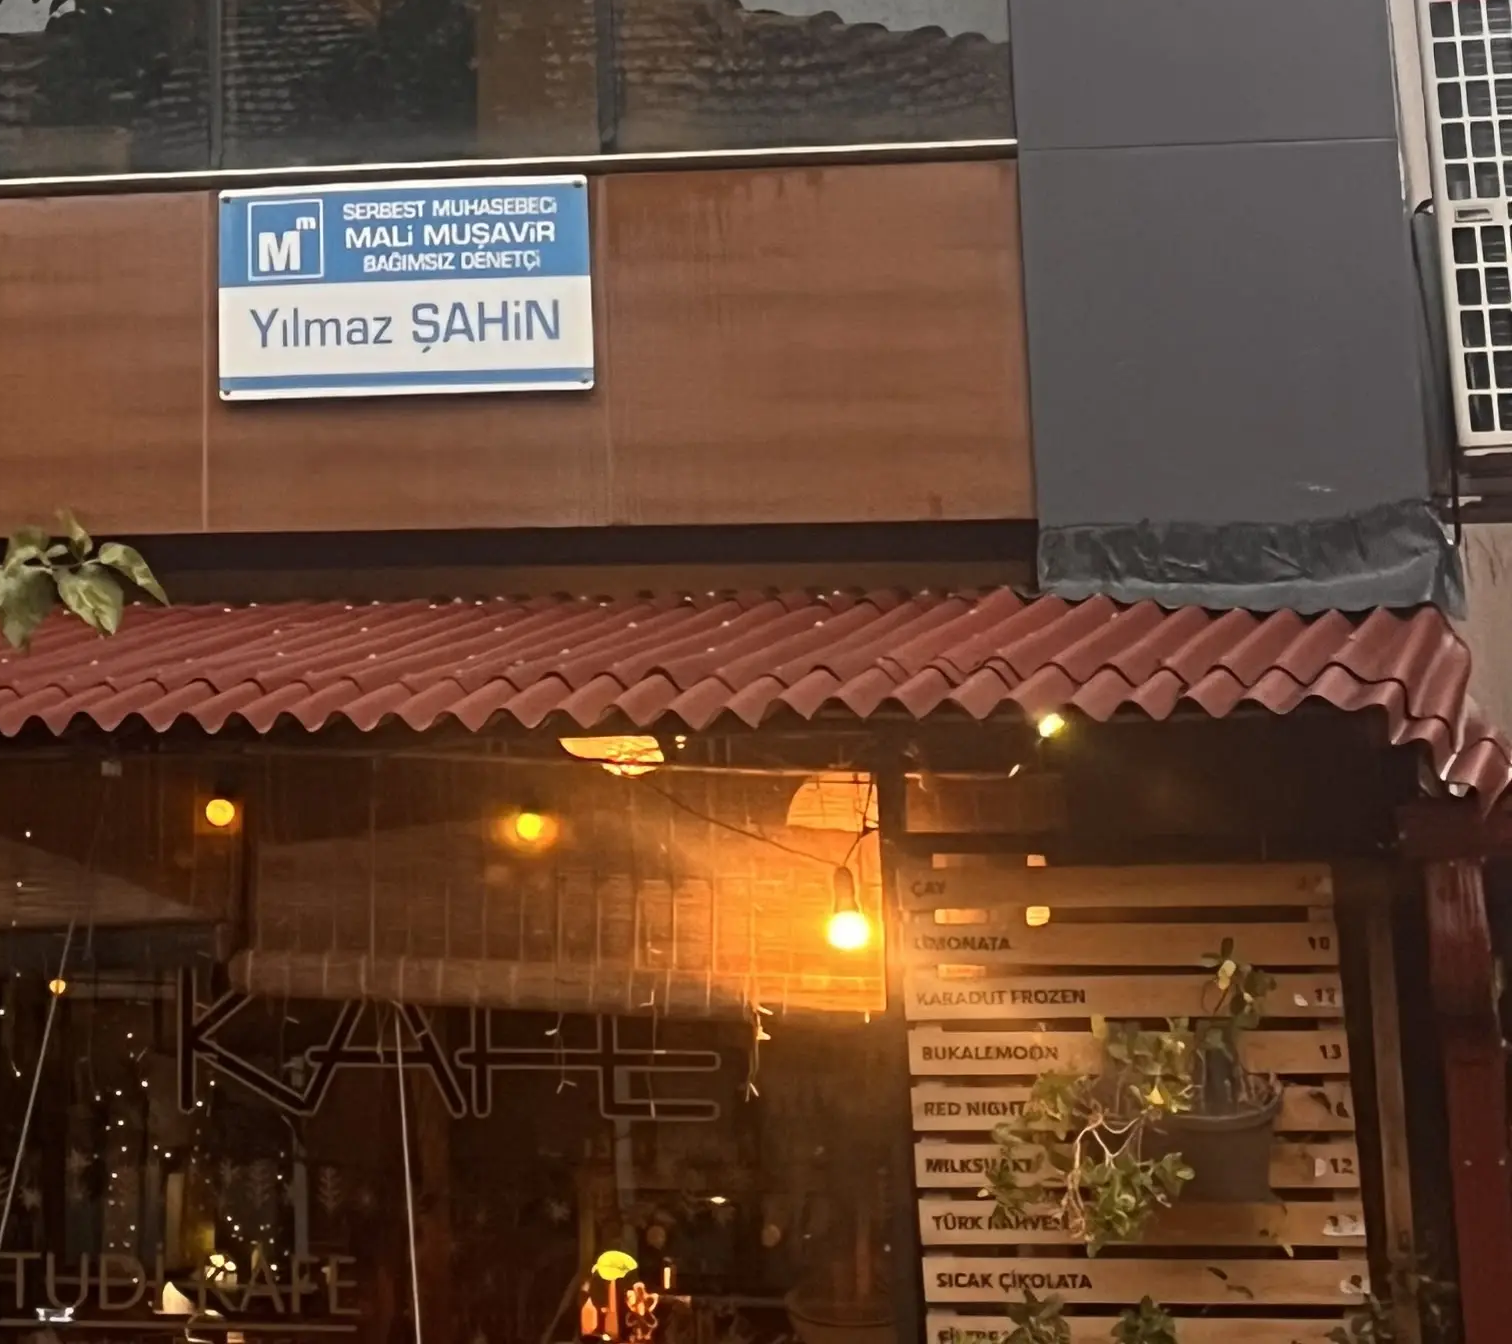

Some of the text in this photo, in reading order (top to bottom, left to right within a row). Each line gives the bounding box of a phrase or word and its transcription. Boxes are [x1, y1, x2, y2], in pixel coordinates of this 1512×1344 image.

[342, 200, 426, 220] SERBEST
[249, 307, 393, 349] Yılmaz
[1011, 989, 1086, 1005] FROZEN
[924, 1101, 961, 1116] RED
[936, 1272, 994, 1288] SICAK
